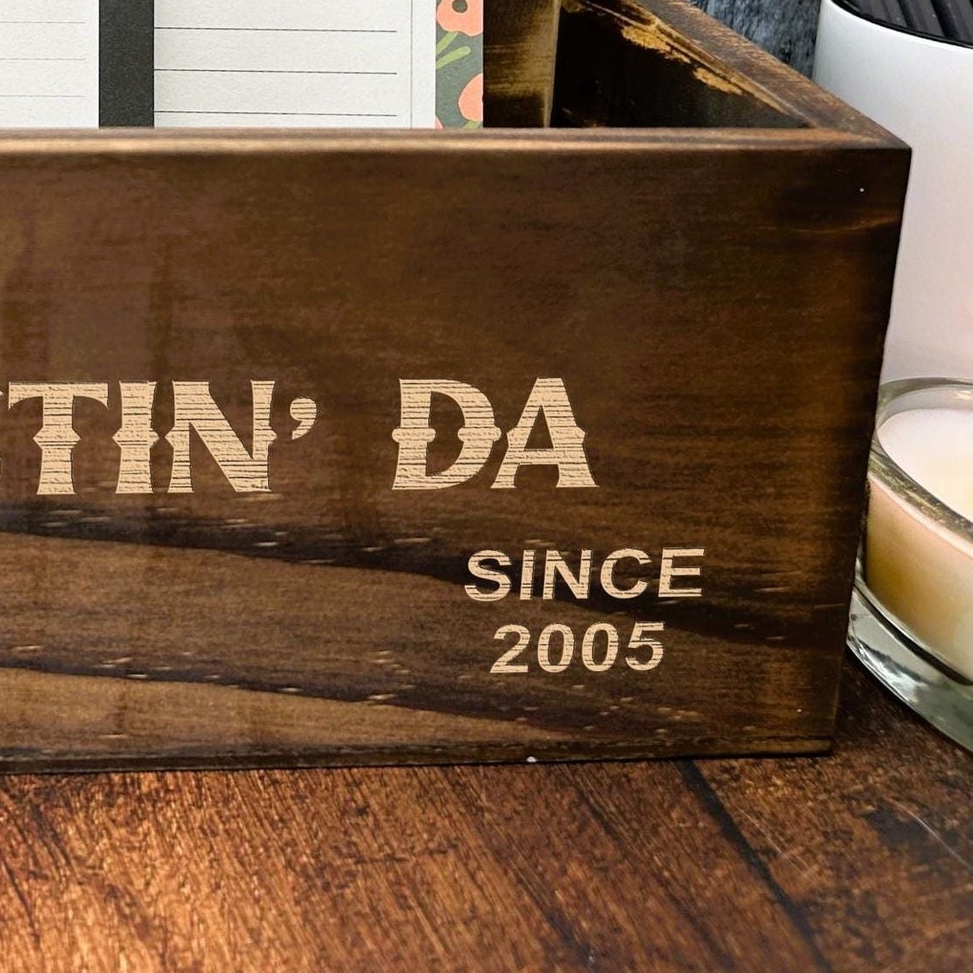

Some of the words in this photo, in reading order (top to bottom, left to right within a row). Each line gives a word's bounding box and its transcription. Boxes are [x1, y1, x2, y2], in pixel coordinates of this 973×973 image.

[392, 377, 598, 491] DA
[465, 548, 705, 603] SINCE
[491, 622, 665, 675] 2005
